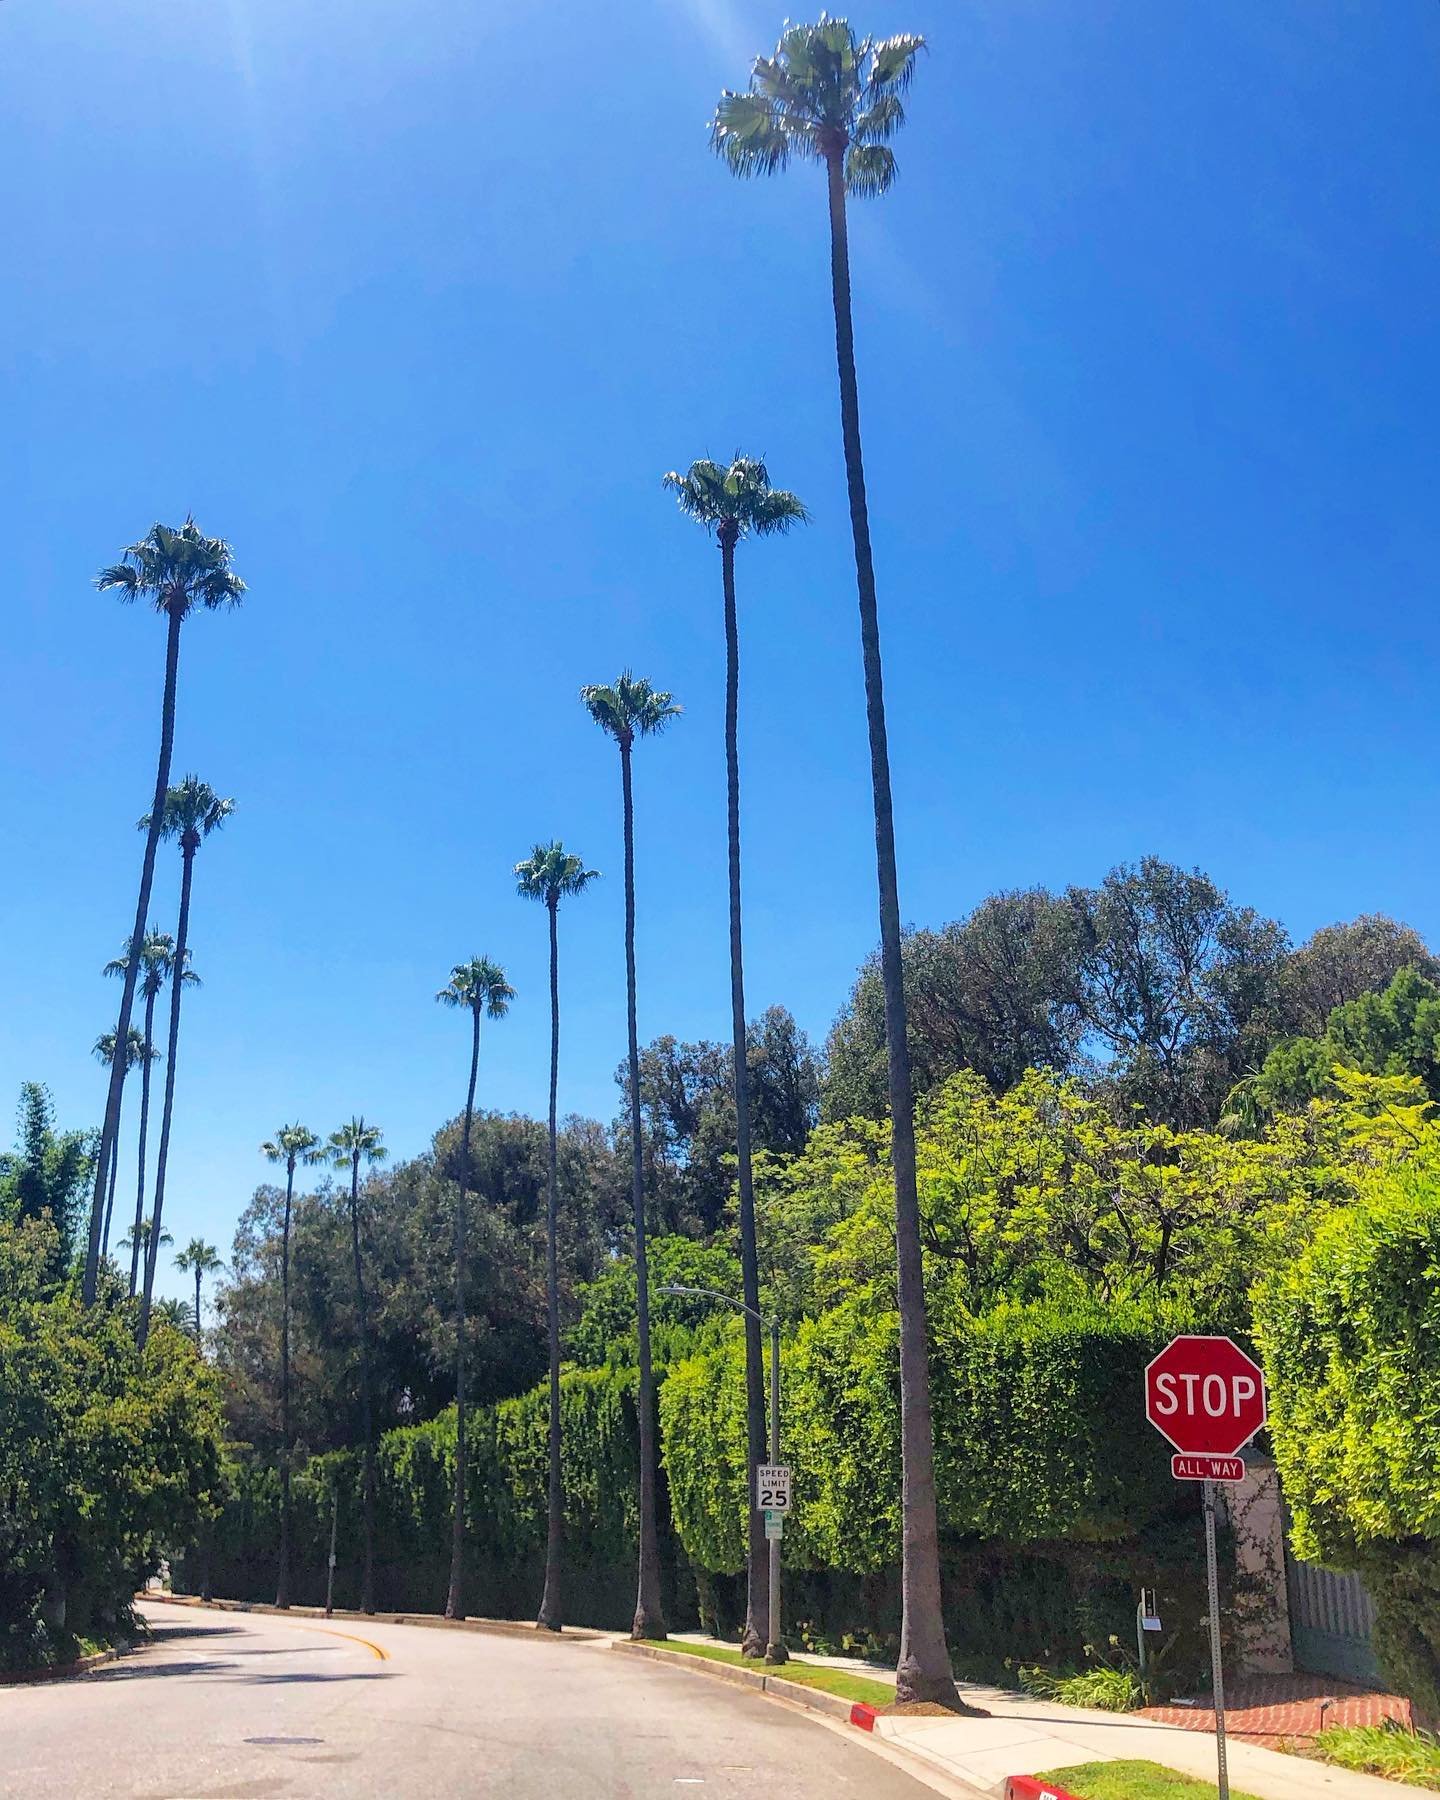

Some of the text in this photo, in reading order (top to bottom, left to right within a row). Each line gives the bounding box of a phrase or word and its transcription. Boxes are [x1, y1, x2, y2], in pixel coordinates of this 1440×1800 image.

[1155, 1373, 1256, 1417] STOP
[760, 1469, 789, 1478] SPEED
[1178, 1460, 1238, 1475] ALL WAY
[761, 1490, 787, 1506] 25
